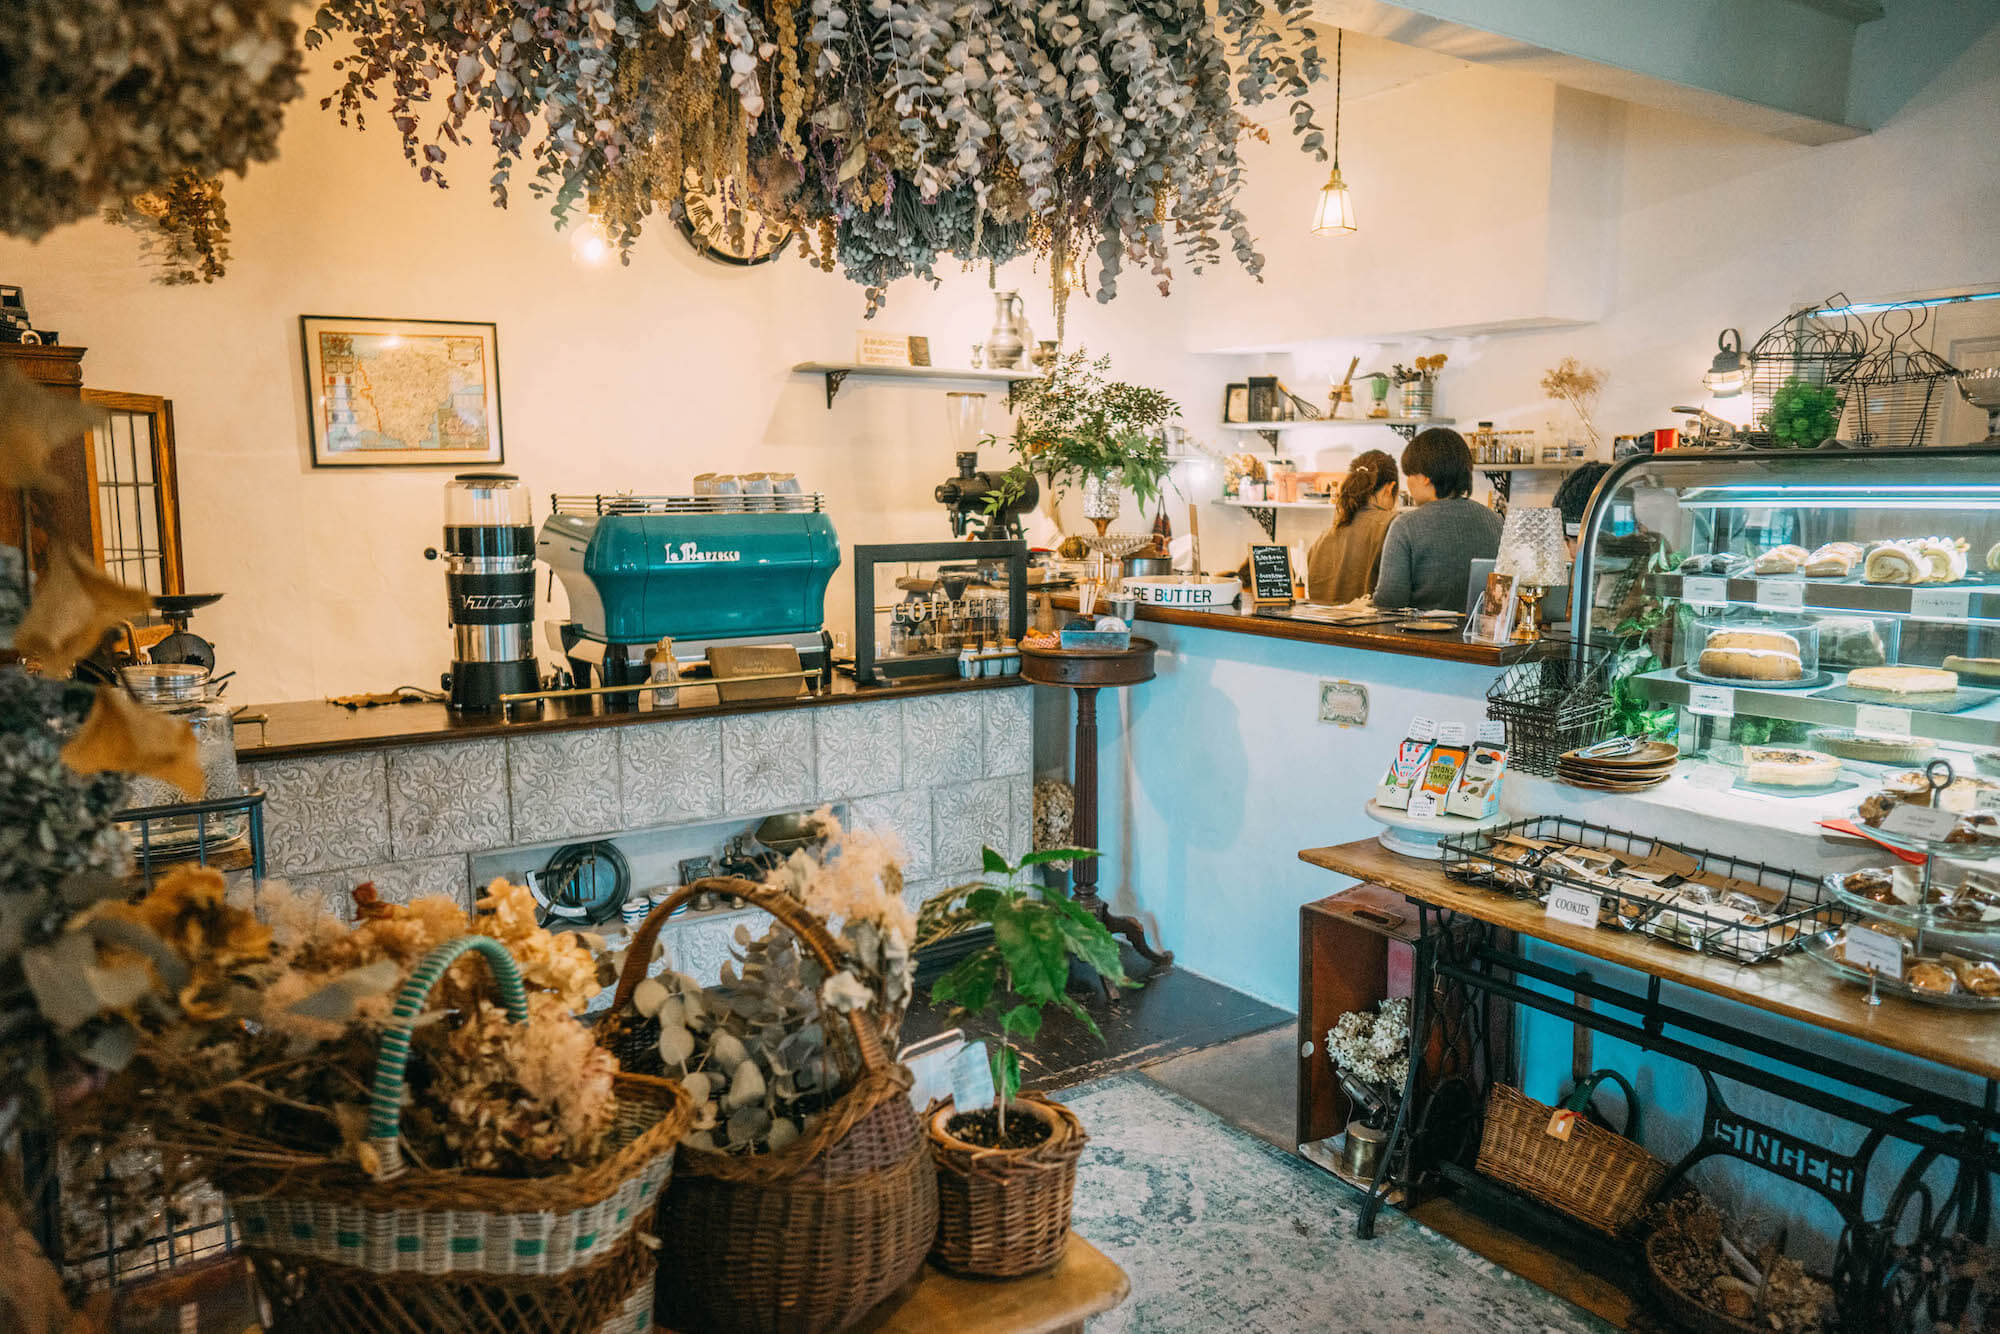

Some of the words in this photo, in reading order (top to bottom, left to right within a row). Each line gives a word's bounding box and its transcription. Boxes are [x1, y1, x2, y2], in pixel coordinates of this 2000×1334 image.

[1154, 588, 1212, 603] BUTTER
[1555, 898, 1590, 916] COOKIES
[1715, 1117, 1857, 1195] SINGER
